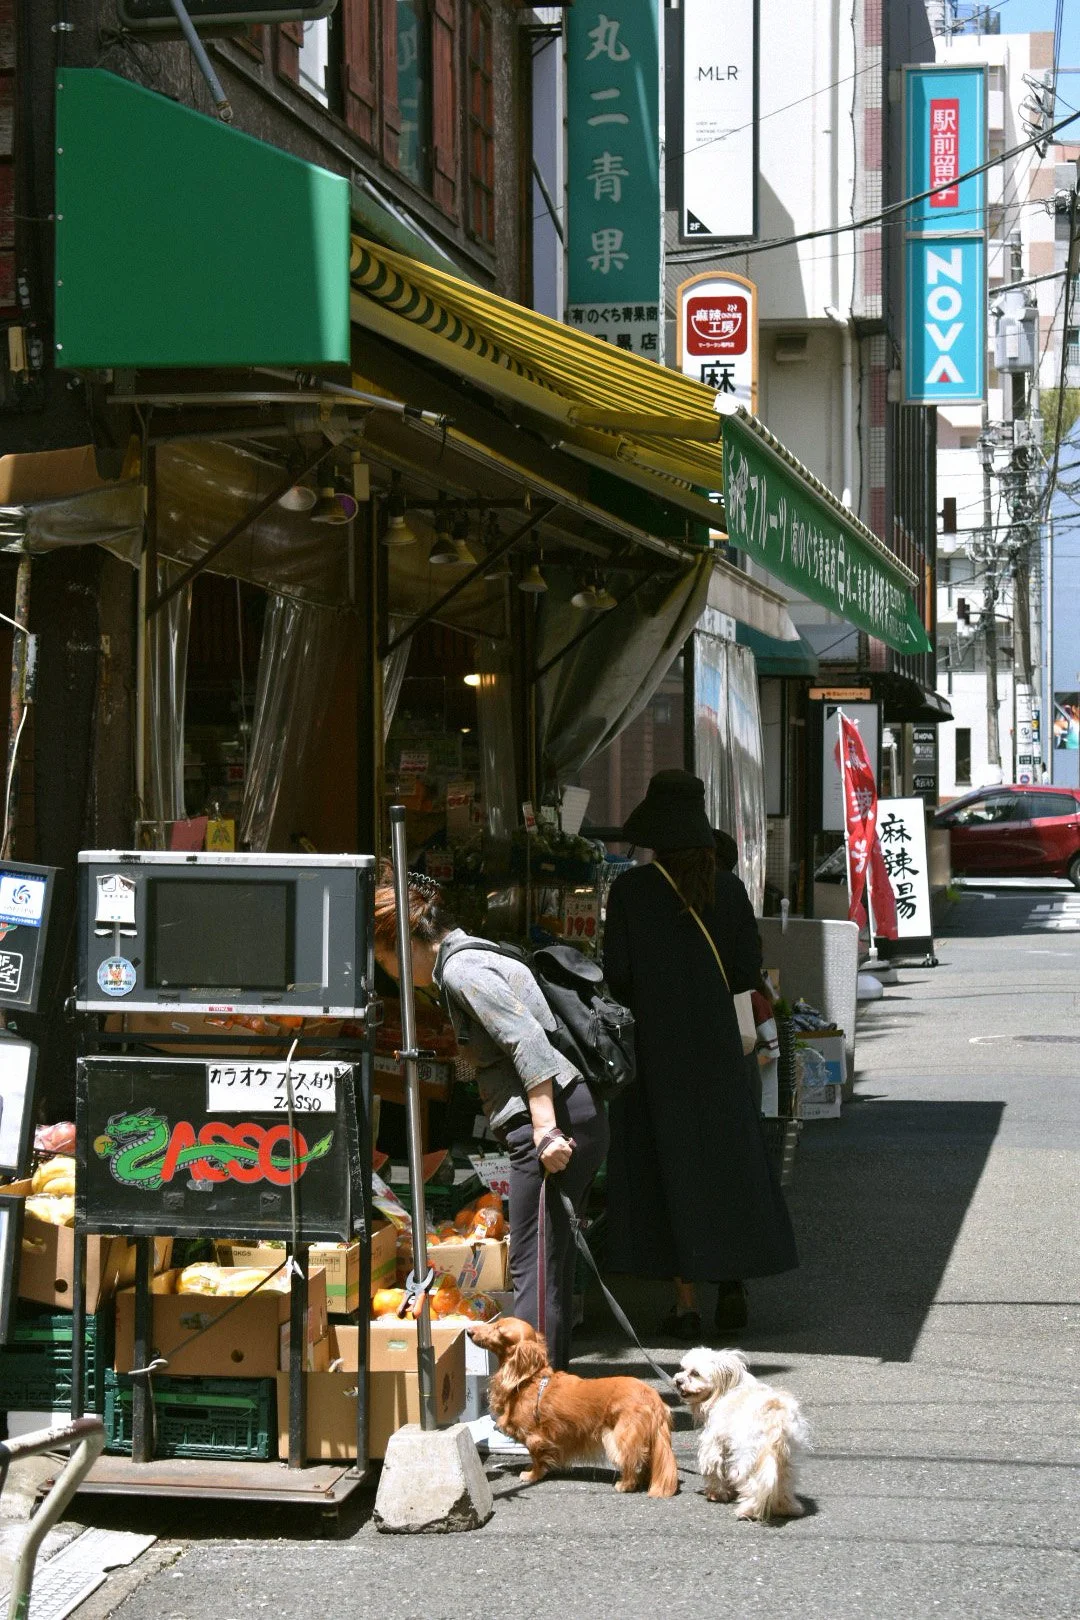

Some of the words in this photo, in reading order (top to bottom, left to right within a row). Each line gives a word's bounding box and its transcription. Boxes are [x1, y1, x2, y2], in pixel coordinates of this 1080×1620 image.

[698, 65, 739, 81] MLR
[584, 13, 632, 275] 丸二青果
[932, 108, 957, 201] 駅前留学
[689, 221, 701, 231] 2F
[708, 320, 735, 333] 工房
[924, 248, 965, 384] NOVA
